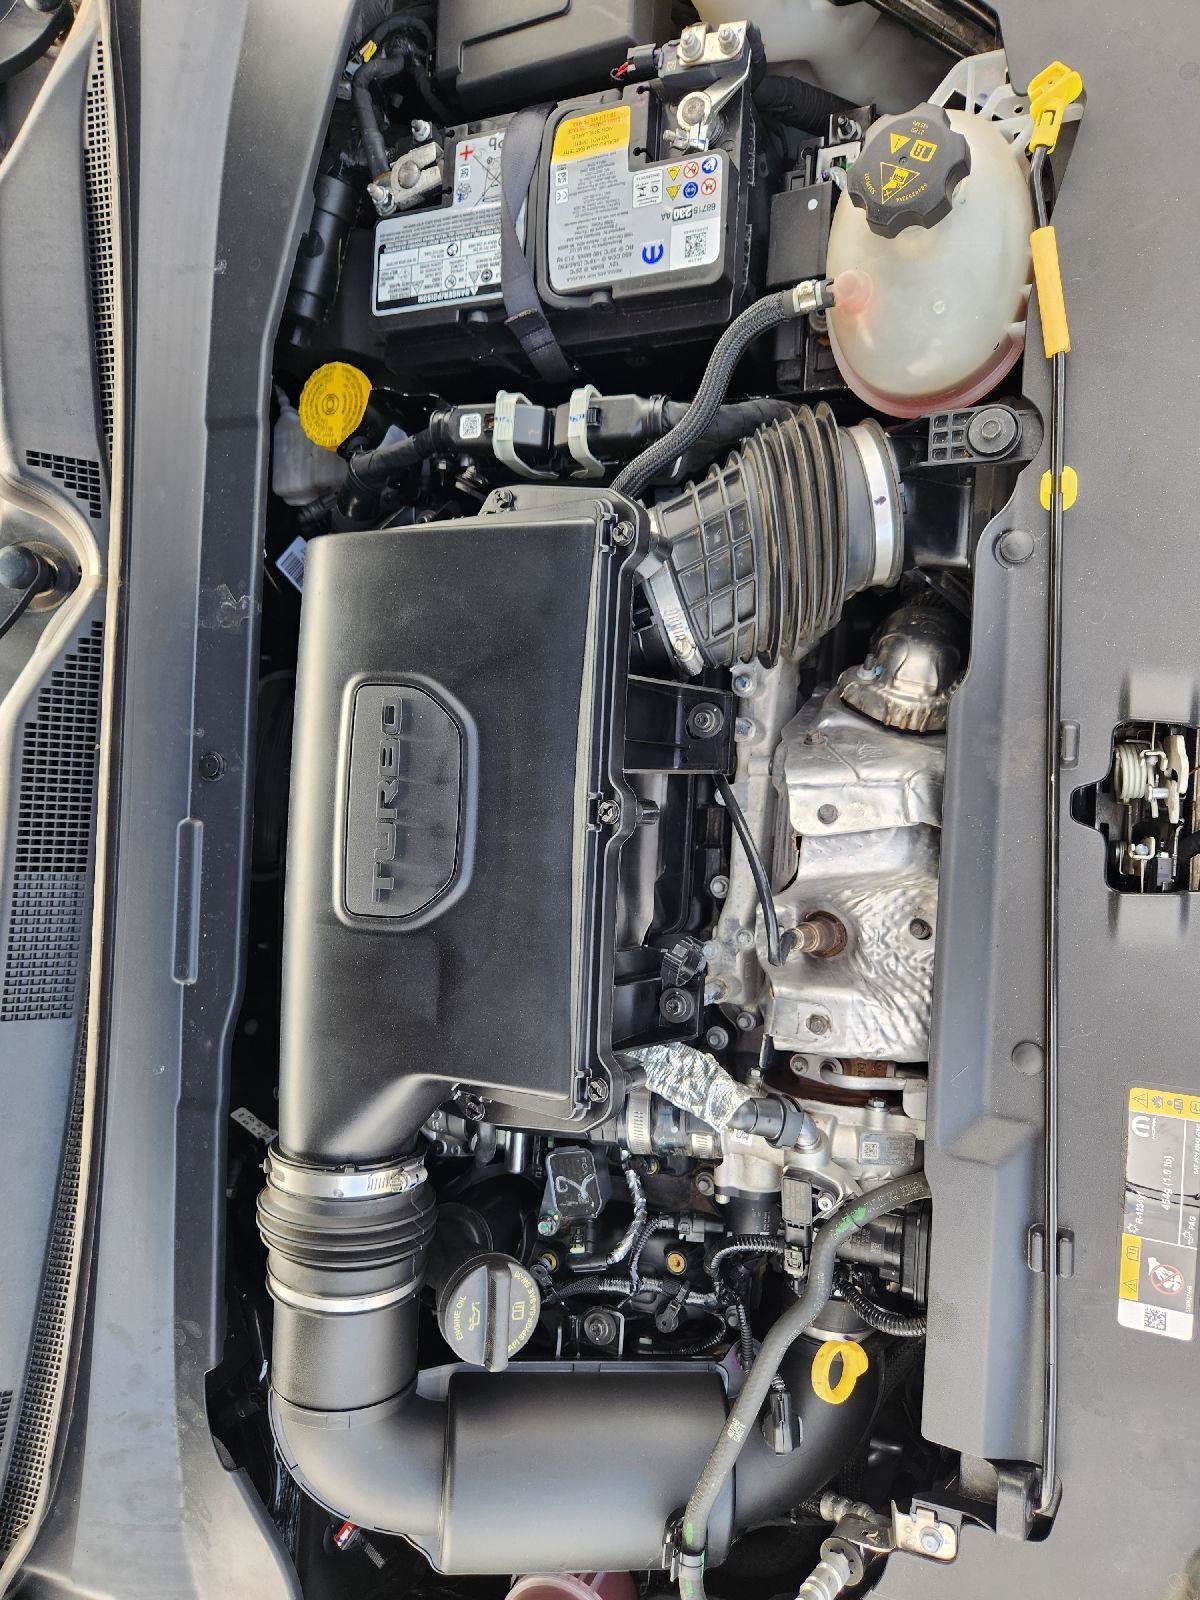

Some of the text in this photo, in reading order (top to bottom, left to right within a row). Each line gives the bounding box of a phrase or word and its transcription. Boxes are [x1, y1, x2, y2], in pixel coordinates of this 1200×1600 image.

[371, 694, 403, 903] TURBO
[1161, 1155, 1174, 1211] 454g (1.0 lb)
[1188, 1215, 1196, 1230] PAG
[453, 1295, 467, 1341] ENGINE OIL
[507, 1340, 520, 1352] API
